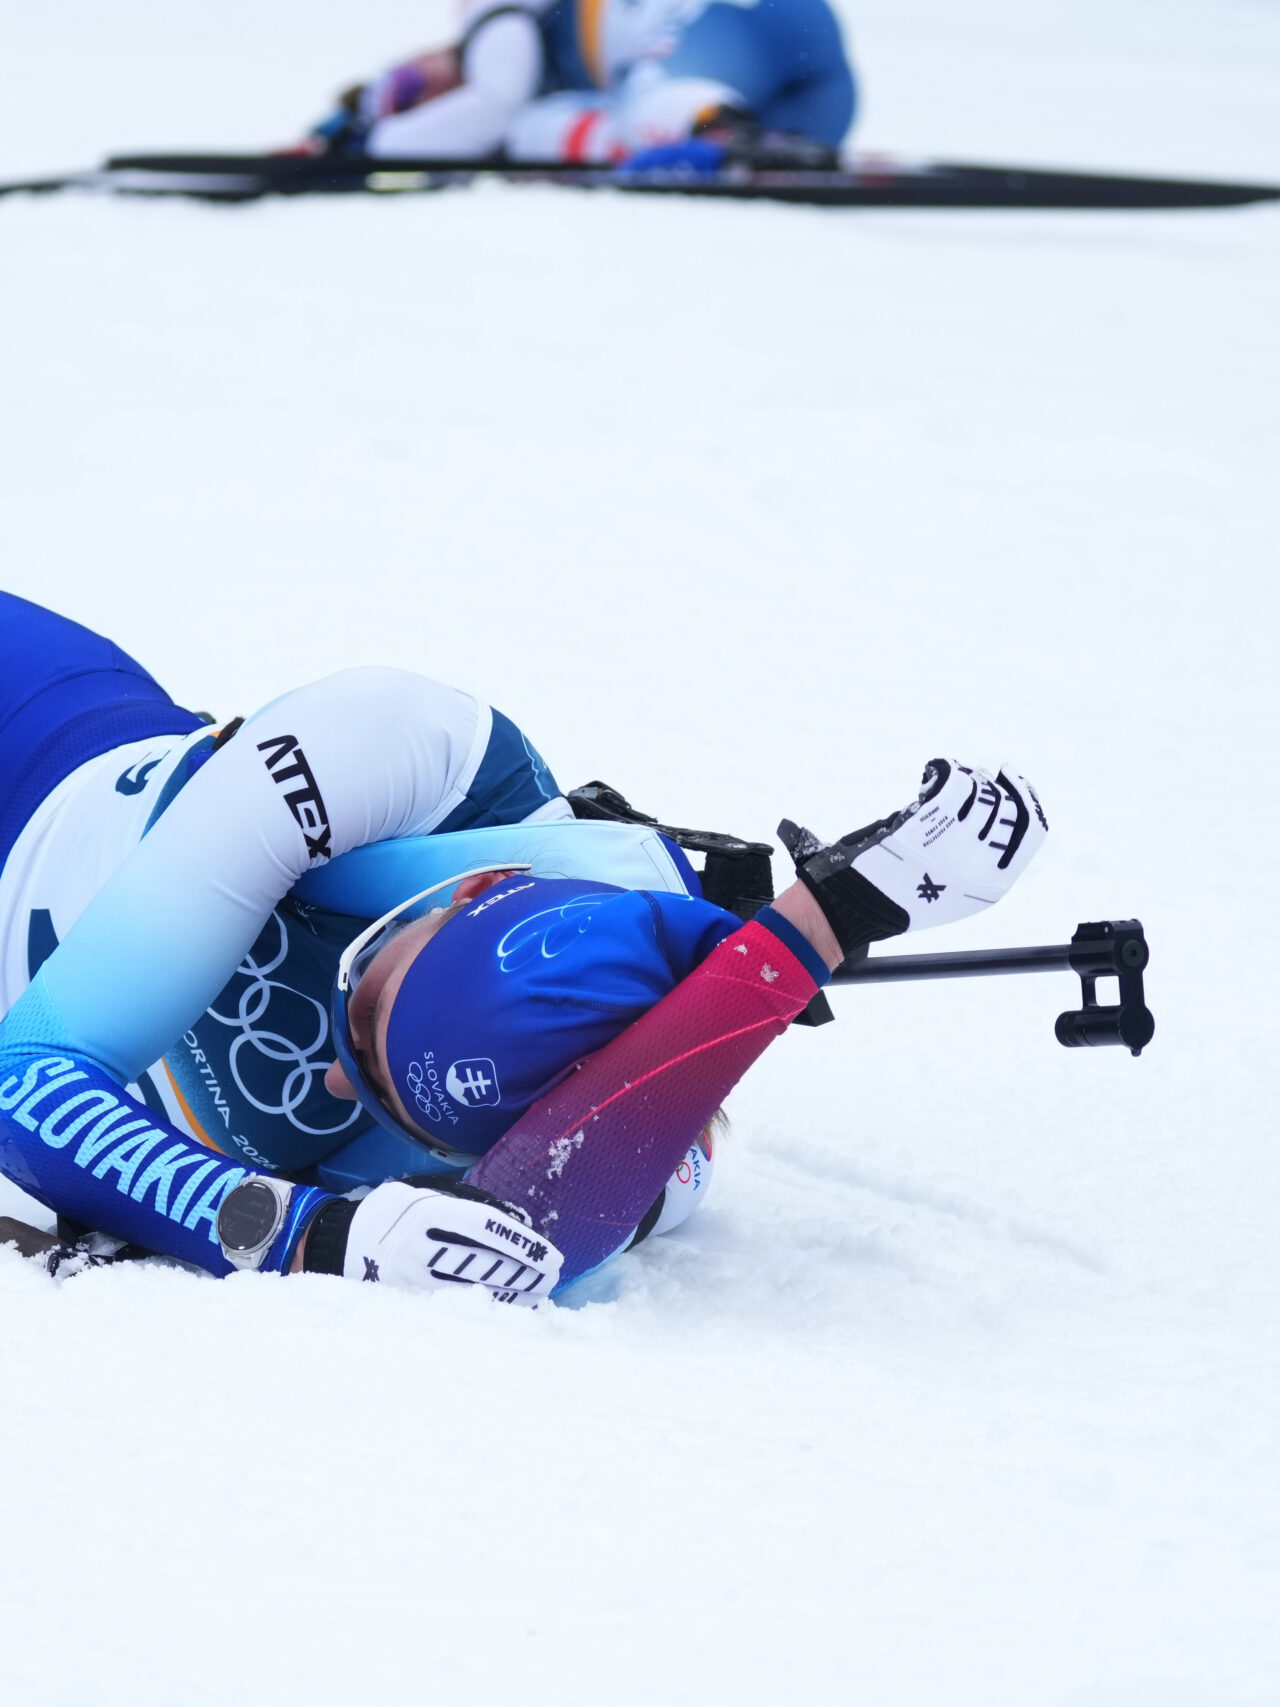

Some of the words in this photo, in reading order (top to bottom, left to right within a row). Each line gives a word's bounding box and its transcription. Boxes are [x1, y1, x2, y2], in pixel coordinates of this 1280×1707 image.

[256, 734, 331, 860] ATEX
[183, 1030, 230, 1129] ORTINA
[424, 1051, 459, 1125] SLOVAKIA
[689, 1146, 701, 1191] AKIA
